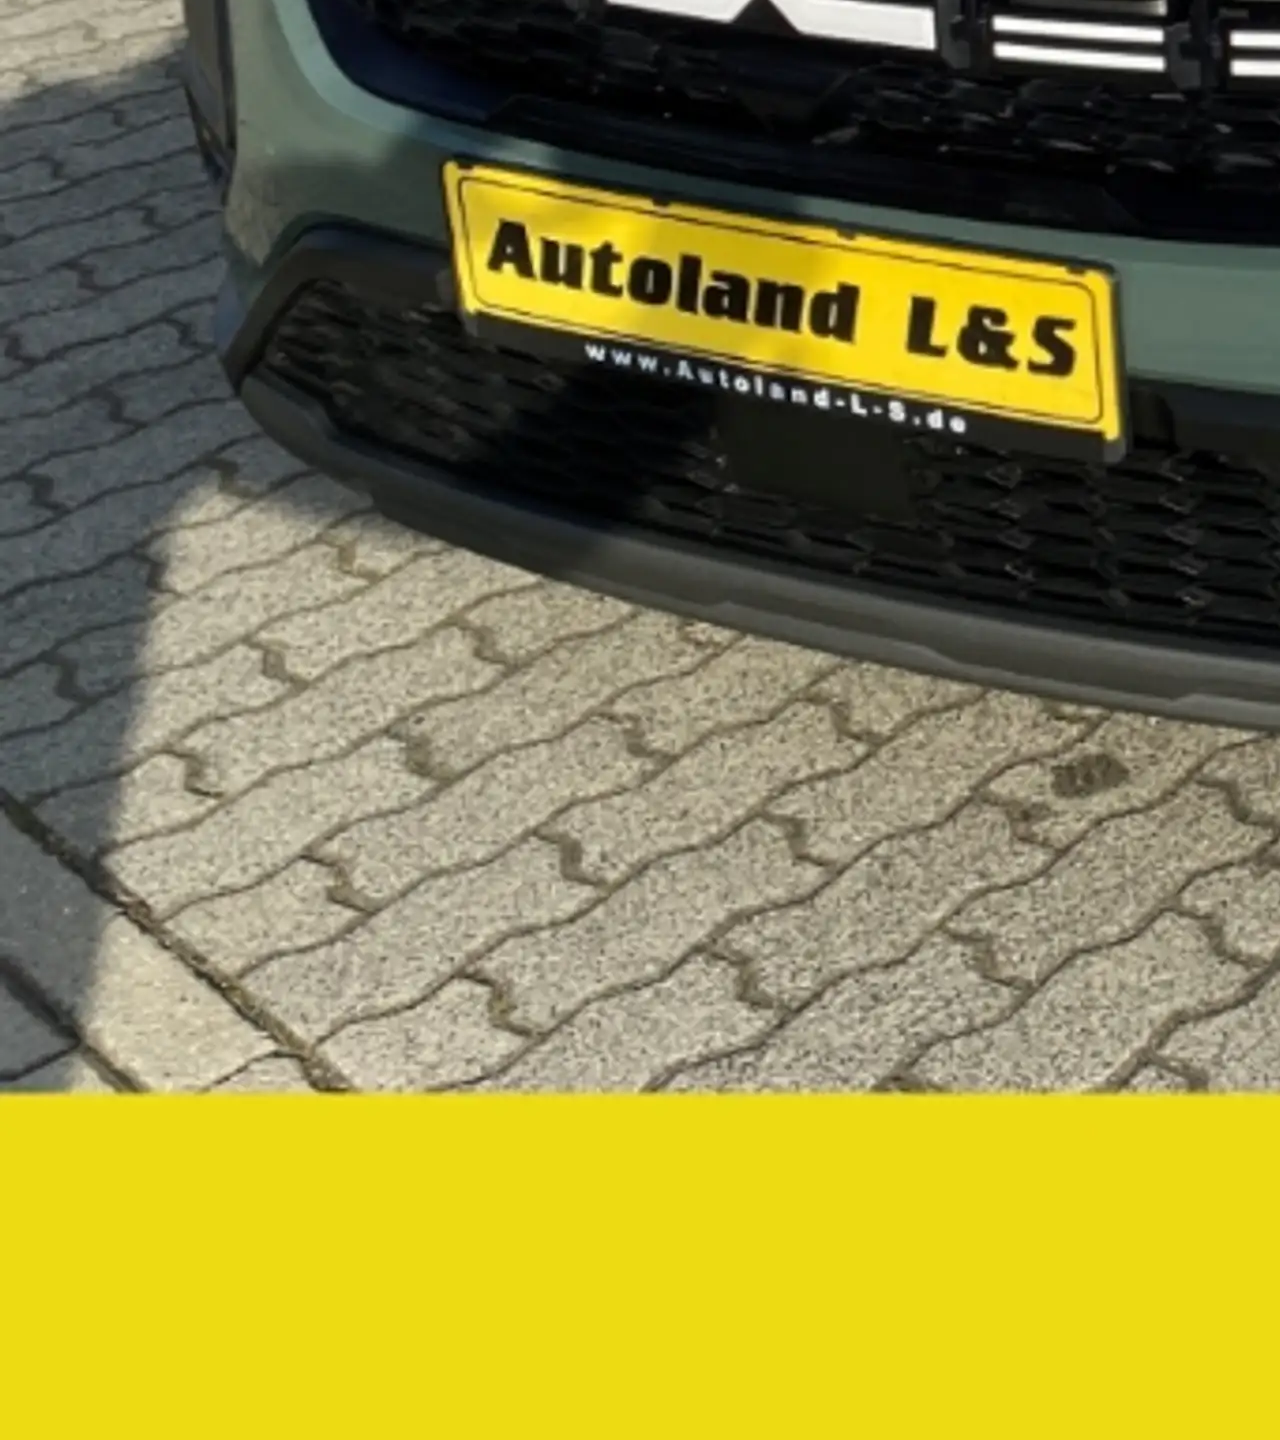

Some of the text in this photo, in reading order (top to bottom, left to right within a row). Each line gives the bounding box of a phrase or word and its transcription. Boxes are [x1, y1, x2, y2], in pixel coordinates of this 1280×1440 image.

[488, 220, 1075, 377] Autoland L&S
[583, 343, 968, 435] www.Autoland-L-S.de
